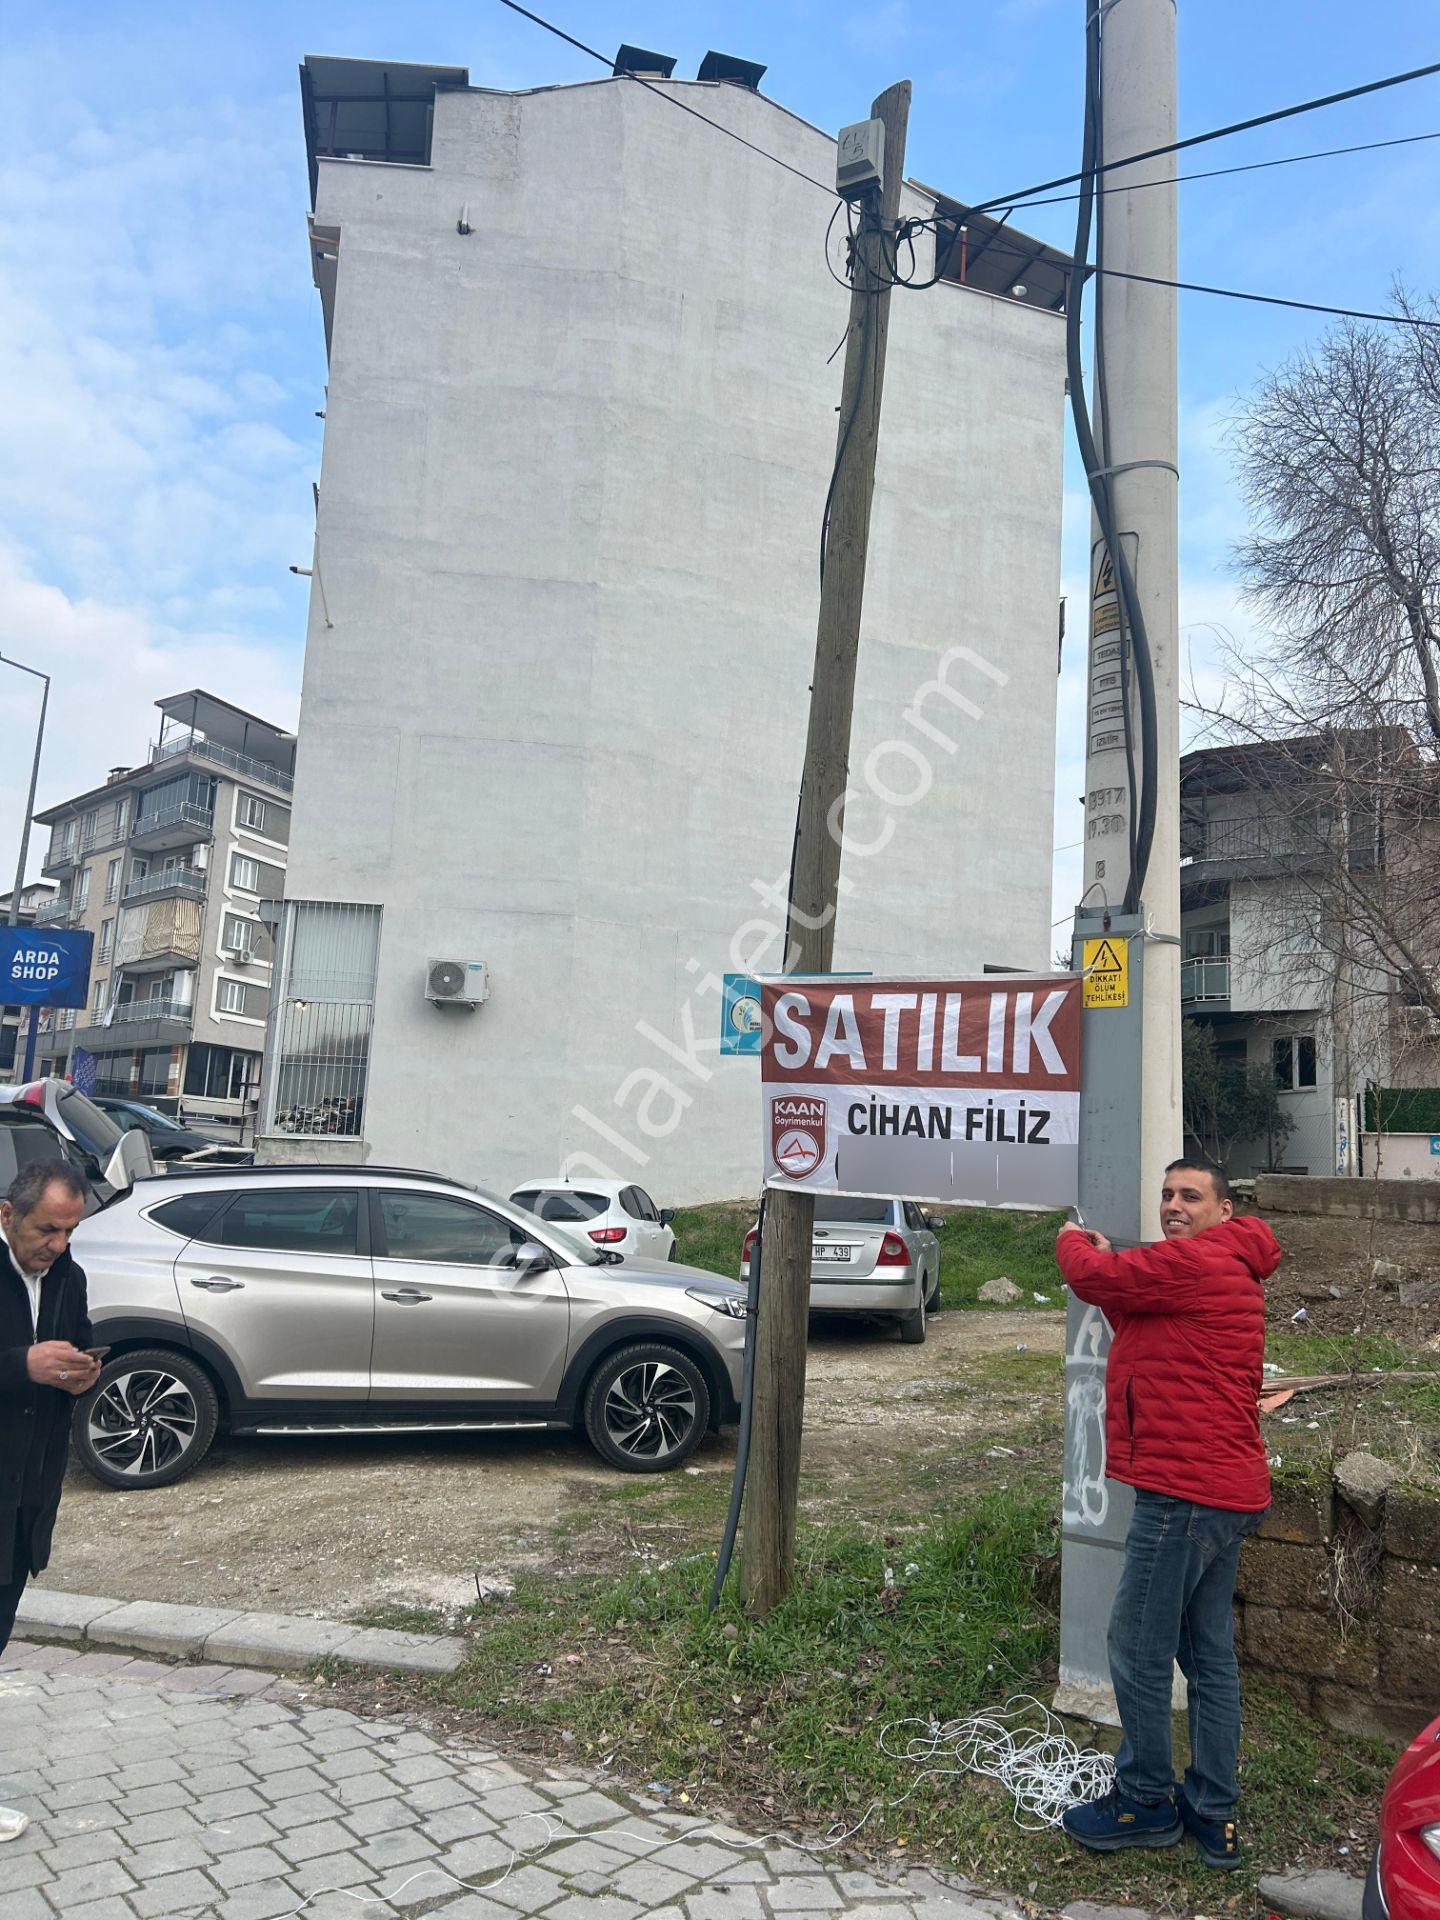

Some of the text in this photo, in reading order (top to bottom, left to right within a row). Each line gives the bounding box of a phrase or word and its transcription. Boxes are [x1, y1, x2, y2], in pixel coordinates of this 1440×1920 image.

[12, 950, 60, 965] ARDA
[11, 965, 59, 980] SHOP
[773, 991, 1069, 1075] SATILIK
[774, 1101, 824, 1116] KAAN
[774, 1116, 823, 1127] Gayrimenkul
[847, 1094, 1052, 1145] CİHAN FİLİZ
[815, 1246, 849, 1257] HP 439
